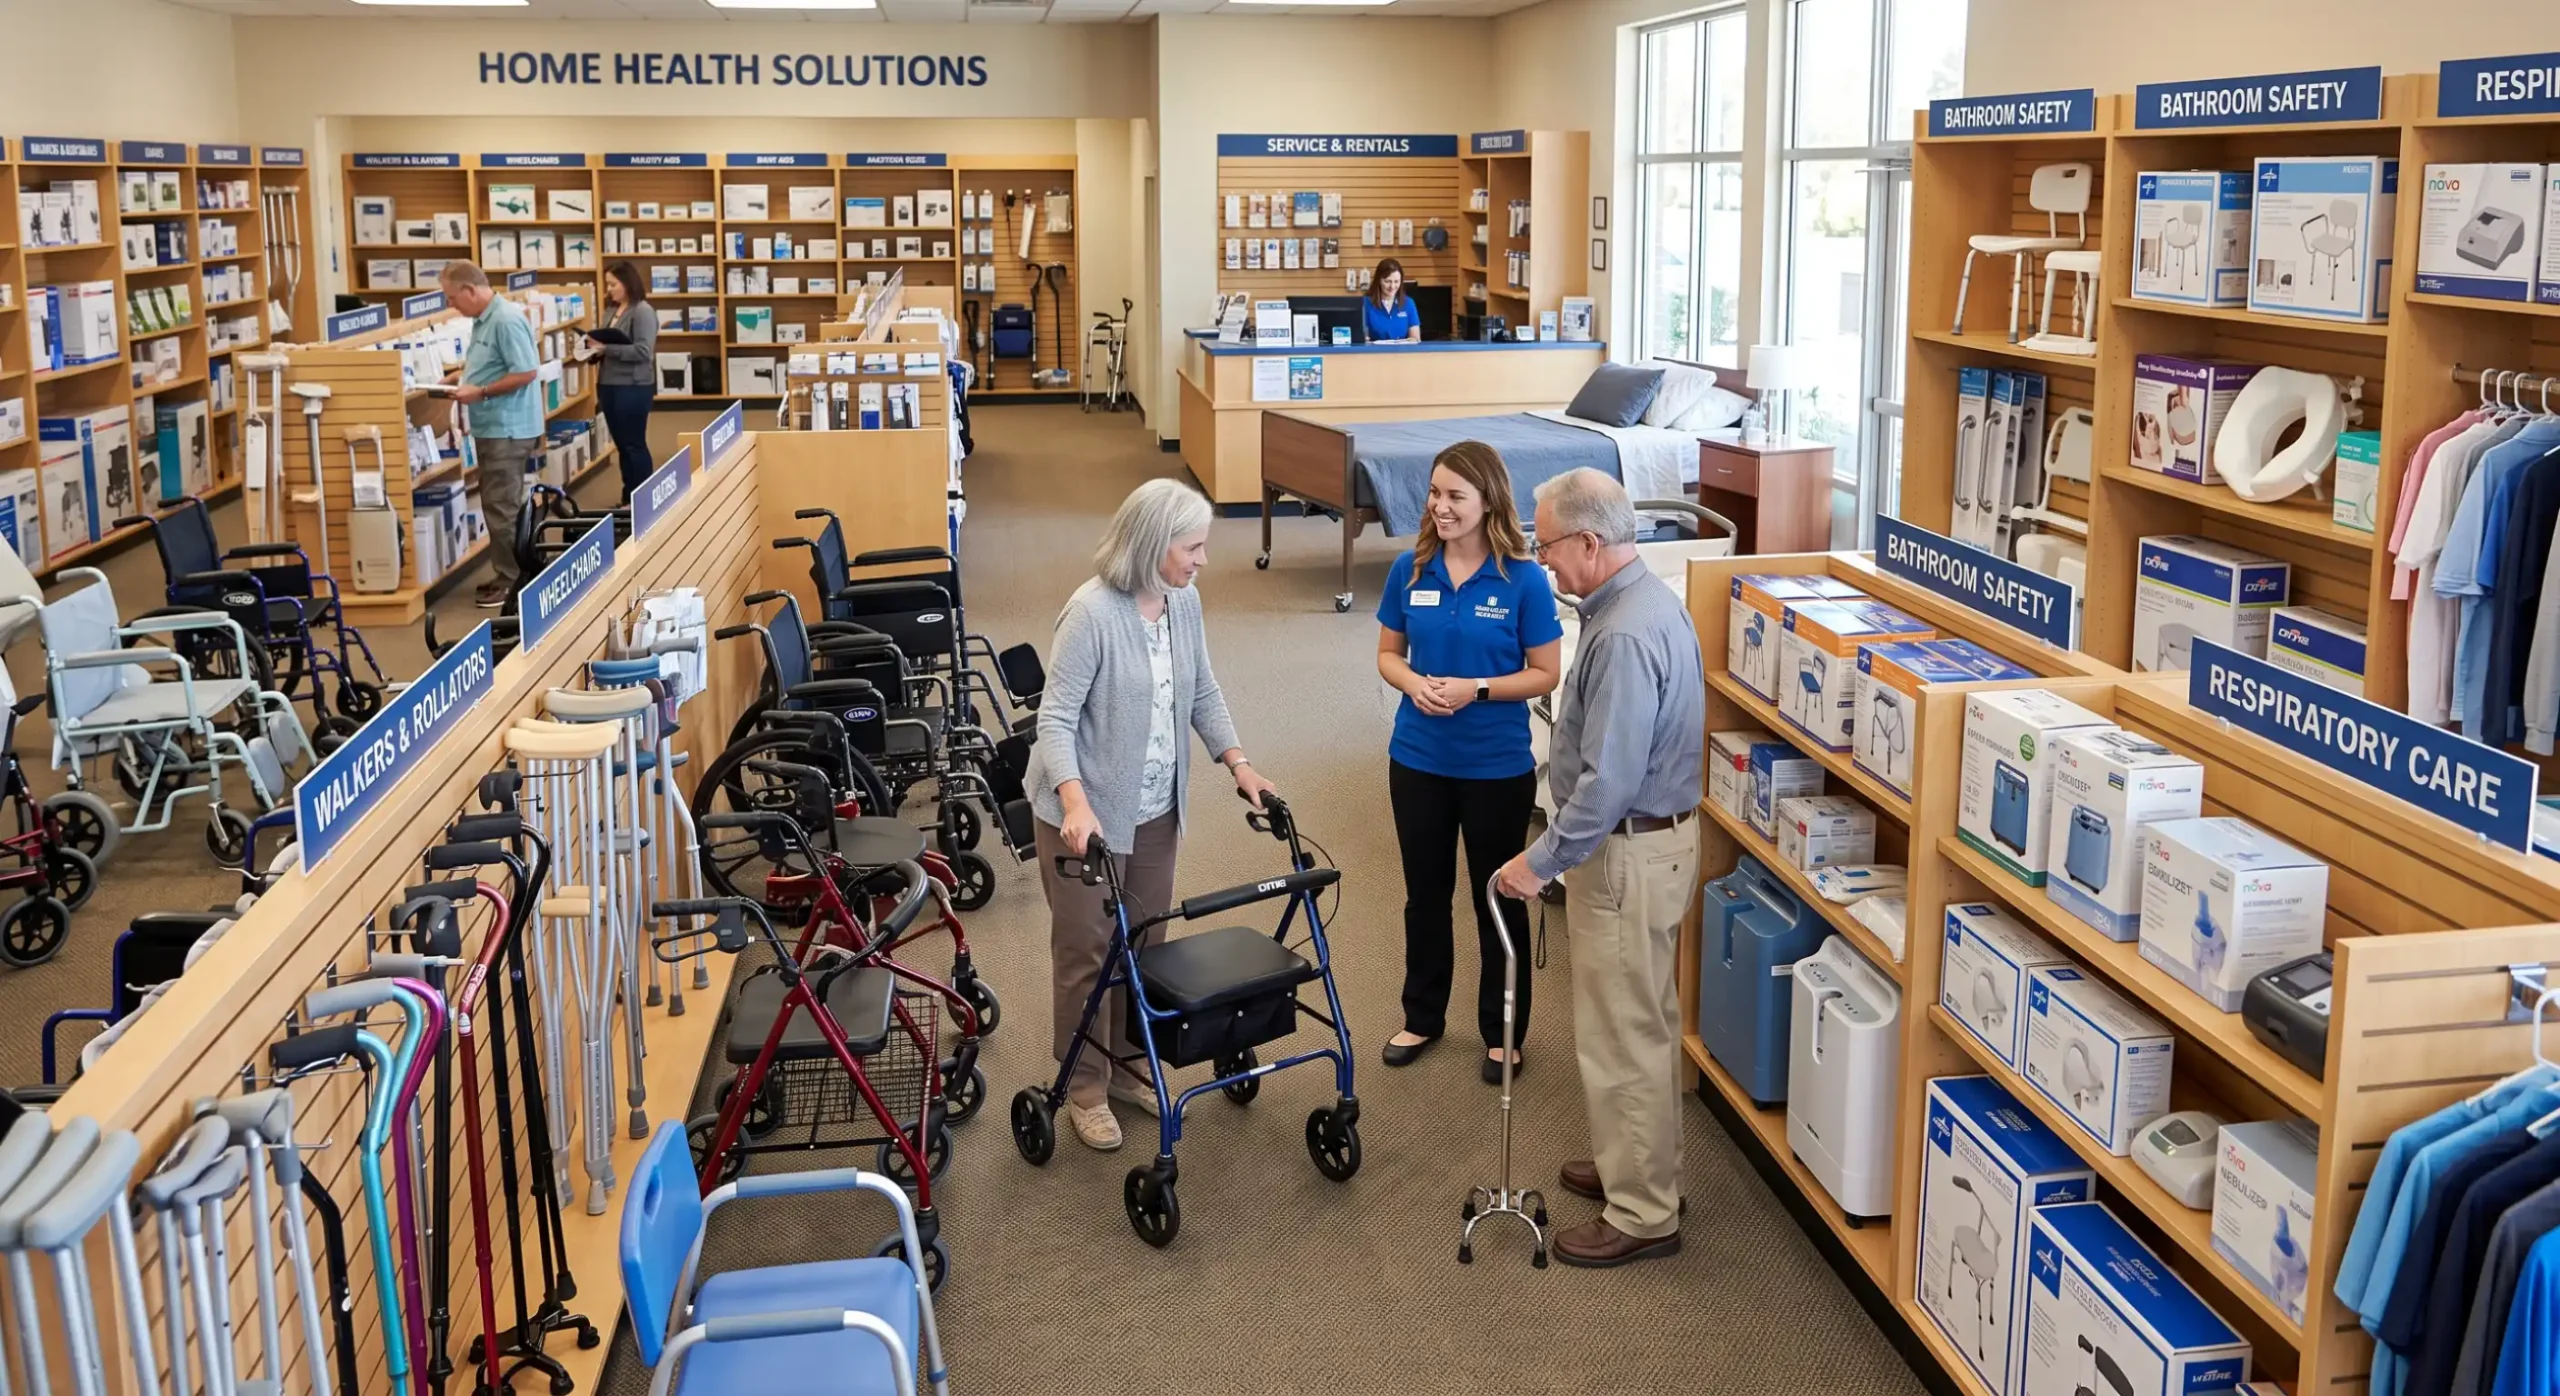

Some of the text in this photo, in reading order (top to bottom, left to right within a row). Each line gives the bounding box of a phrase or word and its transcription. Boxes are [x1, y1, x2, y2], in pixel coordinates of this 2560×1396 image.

[478, 51, 988, 87] HOME HEALTH SOLUTIONS
[2476, 67, 2560, 102] RESPI
[1945, 100, 2072, 131] BATHROOM SAFETY
[2160, 81, 2348, 119] BATHROOM SAFETY
[505, 156, 560, 165] WHEELCHAIRS
[1267, 137, 1410, 153] SERVICE & RENTALS
[2428, 179, 2460, 191] nova
[538, 540, 602, 620] WHEELCHAIRS
[1888, 533, 2054, 624] BATHROOM SAFETY
[313, 644, 487, 833] WALKERS & ROLLATORS
[2209, 663, 2502, 818] RESPIRATORY CARE
[2139, 780, 2165, 791] nova
